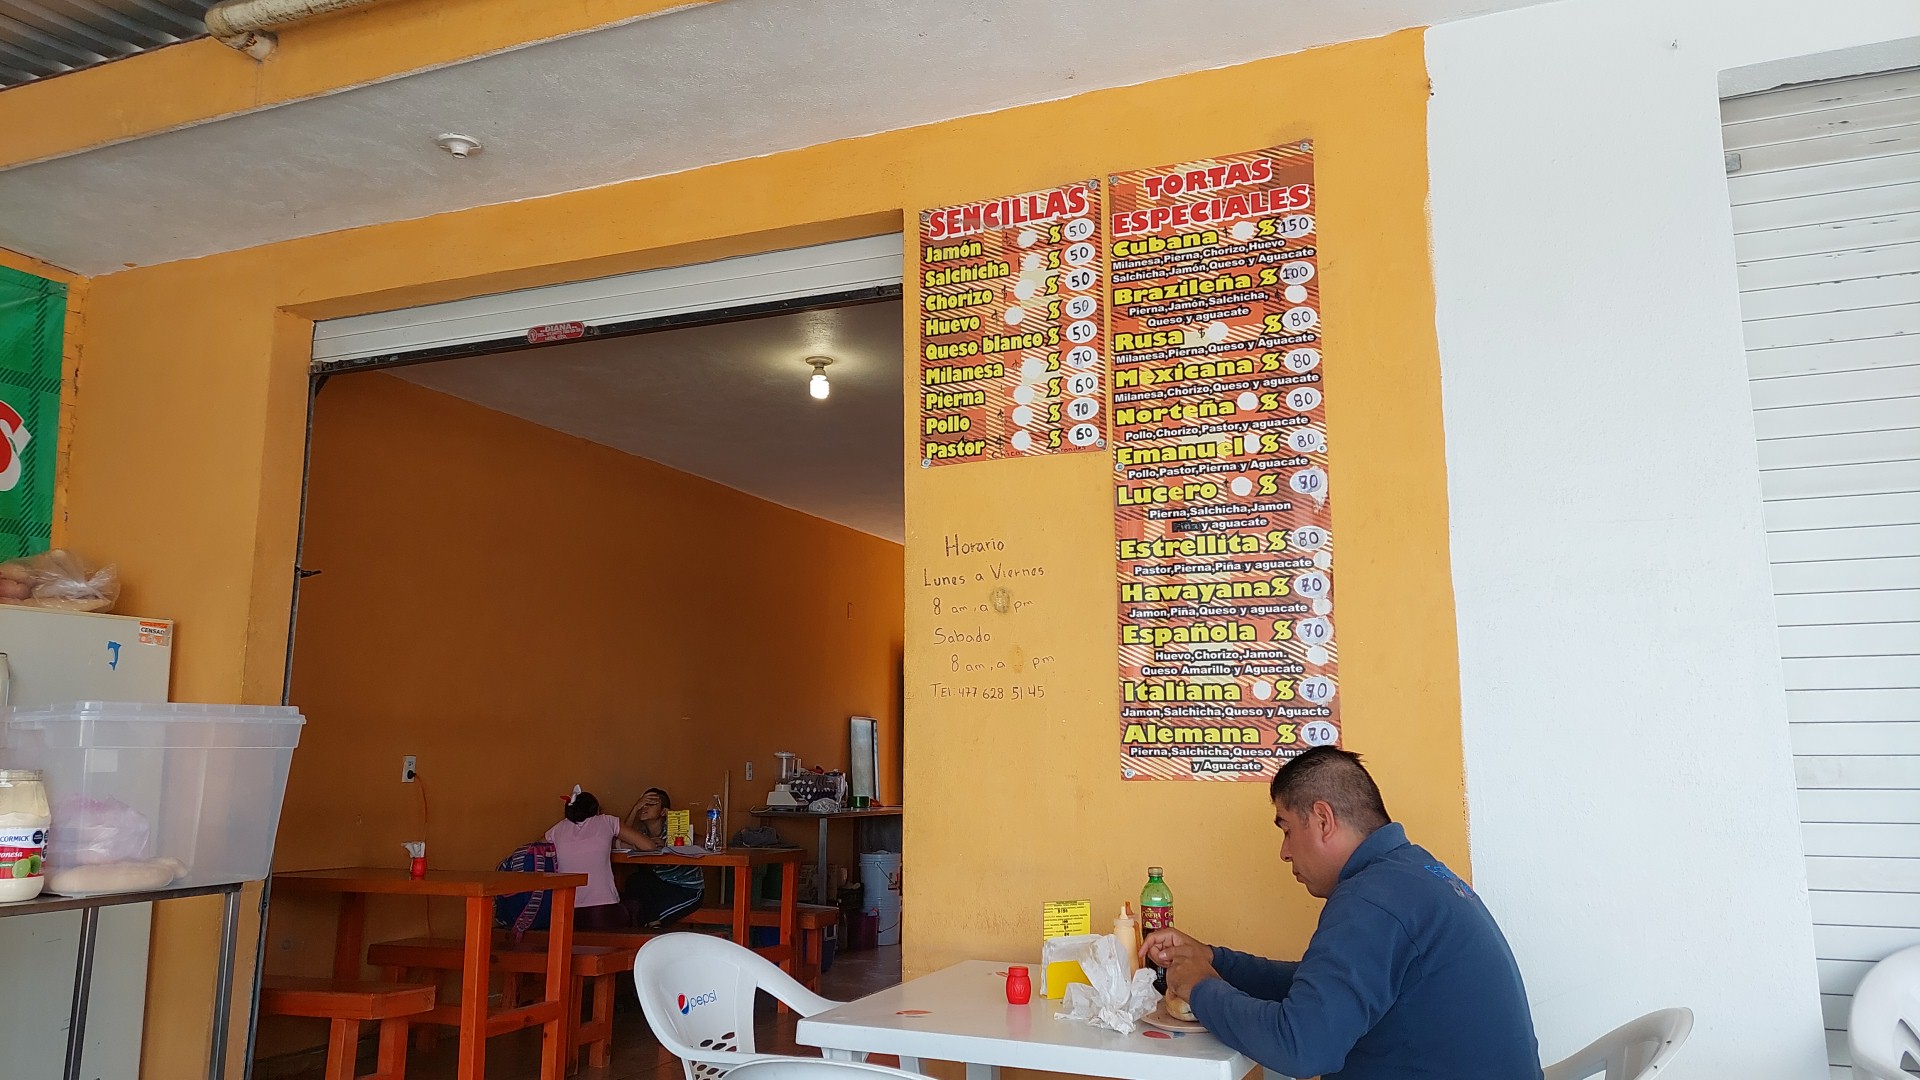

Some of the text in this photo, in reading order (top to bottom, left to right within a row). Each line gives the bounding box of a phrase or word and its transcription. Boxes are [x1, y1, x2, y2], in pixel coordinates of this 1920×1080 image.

[1145, 158, 1272, 198] TORTAS
[929, 187, 1088, 239] SENCILLAS
[1113, 184, 1310, 235] ESPECIALES
[925, 239, 982, 263] Jamón
[1069, 223, 1087, 237] 50
[1113, 230, 1218, 256] Cubana
[1280, 217, 1309, 233] 150
[1258, 248, 1315, 263] Aguacate
[925, 262, 1009, 287] Salchicha
[1070, 247, 1088, 261] 50
[926, 289, 993, 311] Chorizo
[1071, 272, 1090, 287] 50
[1114, 274, 1251, 305] Brazileña
[1283, 267, 1307, 280] 100
[925, 316, 980, 336] Huevo
[1072, 300, 1089, 314] 50
[1147, 312, 1182, 327] Queso
[1196, 307, 1249, 321] aguacate
[545, 324, 571, 333] DIANA
[1114, 329, 1184, 351] Rusa
[1291, 311, 1310, 326] 80
[925, 341, 978, 360] Queso
[982, 332, 1043, 354] blanco
[1072, 324, 1091, 341] 50
[1258, 333, 1314, 347] Aguacate
[925, 363, 1004, 385] Milanesa
[1072, 350, 1092, 365] 70
[1116, 358, 1252, 388] Mexicana
[1293, 353, 1311, 368] 80
[1263, 373, 1319, 387] aguacate
[925, 390, 985, 410] Pierna
[1116, 398, 1234, 425] Norteña
[1294, 393, 1313, 407] 80
[925, 415, 971, 435] Pollo
[1074, 402, 1089, 416] 70
[1252, 415, 1308, 428] aguacate
[926, 437, 986, 459] Pastor
[1117, 437, 1244, 465] Emanuel
[1297, 434, 1315, 447] 80
[1250, 456, 1308, 469] Aguacate
[1117, 482, 1217, 505] Lucero
[1212, 518, 1267, 530] aguacate
[945, 534, 1004, 557] Horario
[1120, 533, 1259, 559] Estrellita
[1300, 532, 1318, 547] 80
[924, 568, 965, 586] Lunes
[990, 563, 1044, 580] Viernes
[1255, 558, 1312, 570] aguacate
[933, 597, 941, 615] 8
[1014, 600, 1034, 613] pm
[1251, 603, 1307, 615] aguacate
[934, 626, 991, 644] Sabado
[1122, 621, 1256, 646] Española
[951, 654, 959, 672] 8
[1032, 655, 1055, 669] pm
[1142, 667, 1178, 677] Queso
[1181, 666, 1231, 675] Amarillo
[1245, 664, 1303, 675] Aguacate
[958, 687, 978, 697] 477
[983, 687, 1004, 699] 628
[1011, 687, 1023, 700] 51
[1028, 685, 1045, 698] 45
[1123, 680, 1241, 702] Italiana
[1277, 707, 1329, 717] Aguacte
[1123, 724, 1260, 744] Alemana
[1275, 748, 1308, 757] Ama
[1203, 761, 1261, 770] Aguacate
[0, 851, 23, 859] onesa
[690, 990, 717, 1010] pepsi
